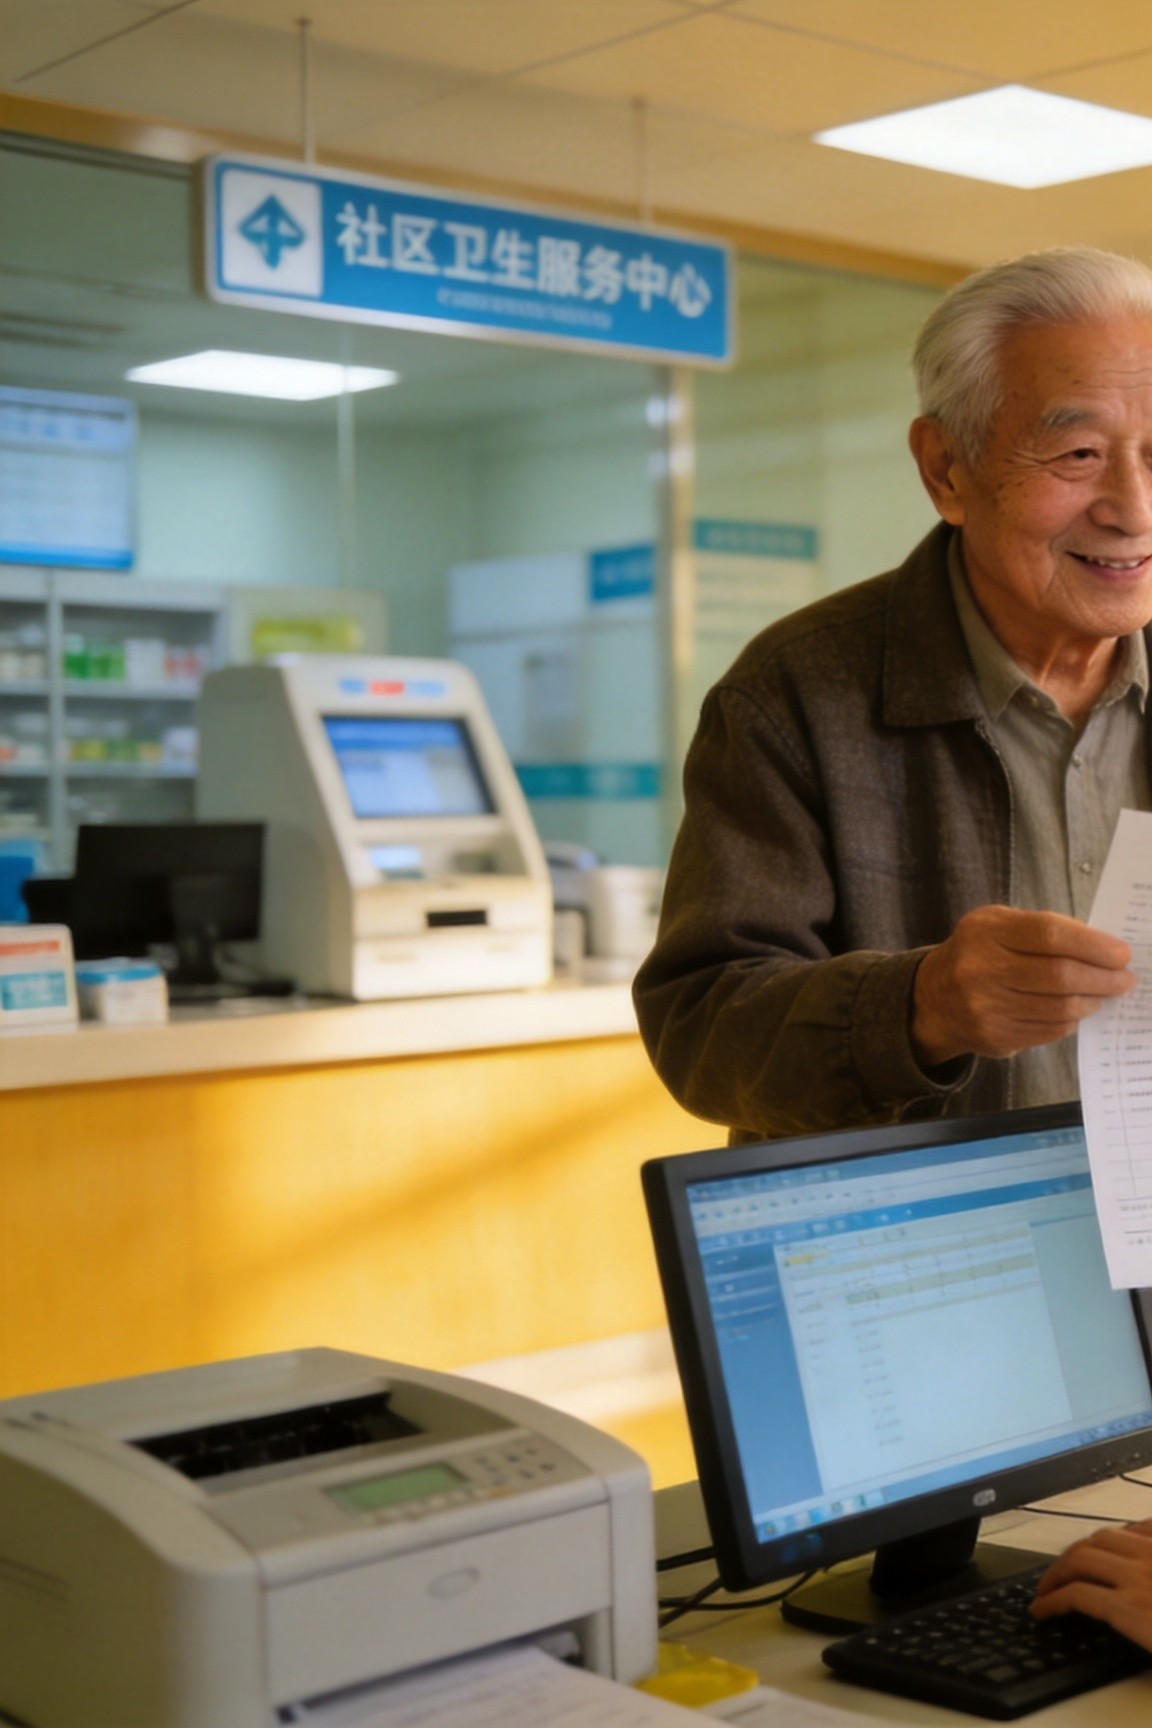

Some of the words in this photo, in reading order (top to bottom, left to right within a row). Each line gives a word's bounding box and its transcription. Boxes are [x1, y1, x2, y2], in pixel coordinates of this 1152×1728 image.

[336, 201, 712, 318] 社区卫生服务中心
